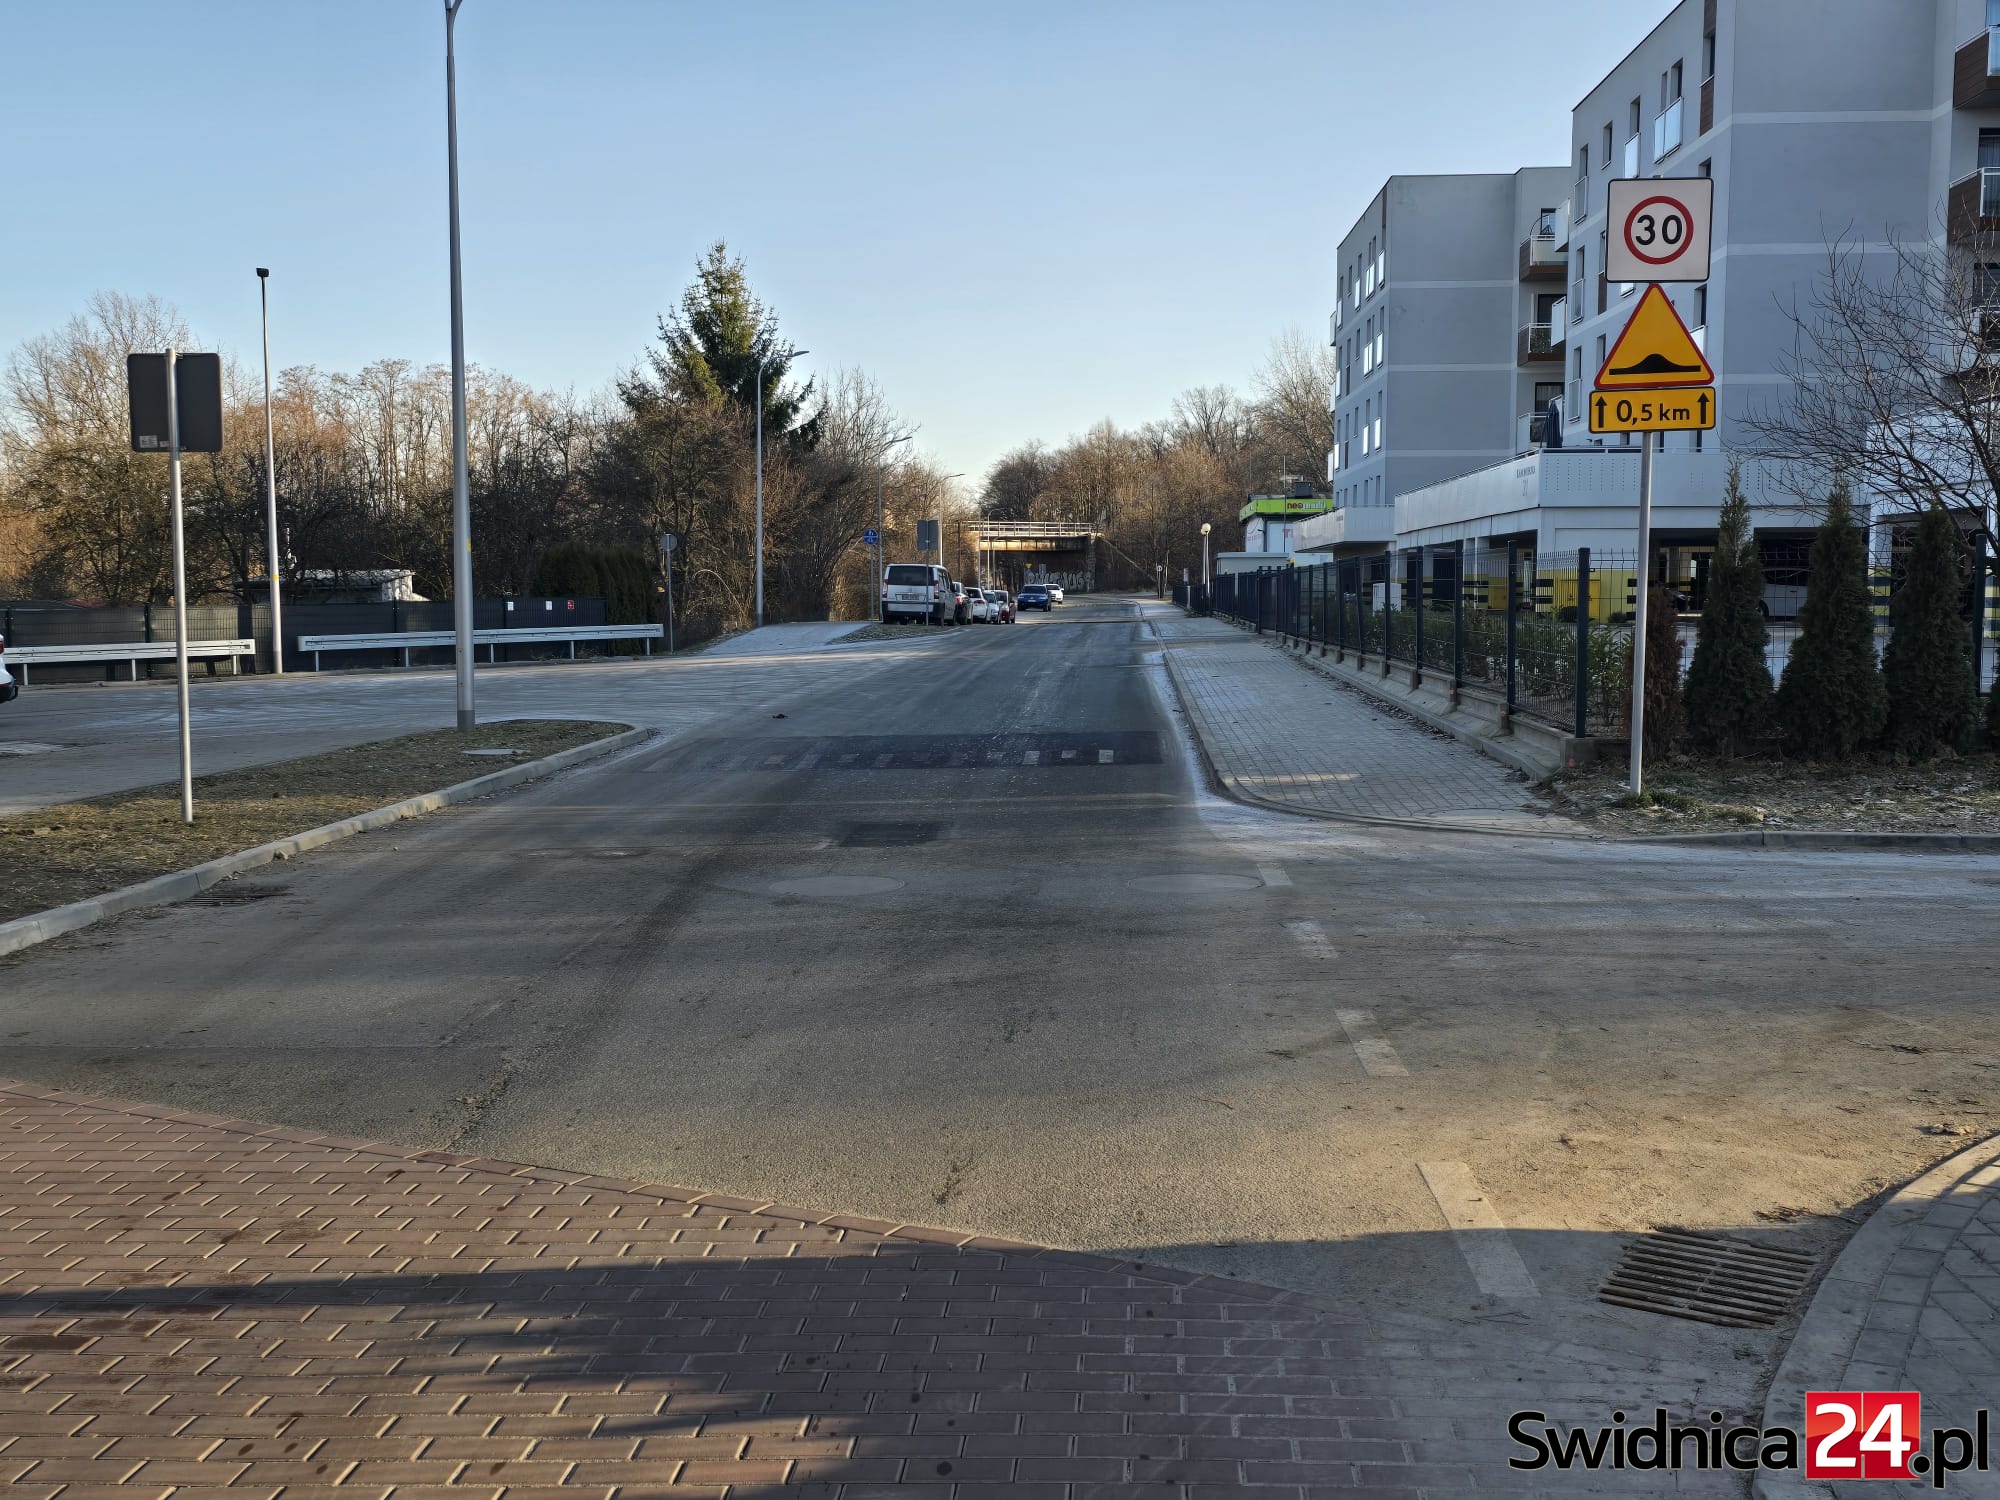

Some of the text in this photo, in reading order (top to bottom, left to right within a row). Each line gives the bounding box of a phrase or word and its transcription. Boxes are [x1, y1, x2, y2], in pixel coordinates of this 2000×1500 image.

[1635, 214, 1683, 246] 30
[1616, 399, 1690, 426] 0,5 km
